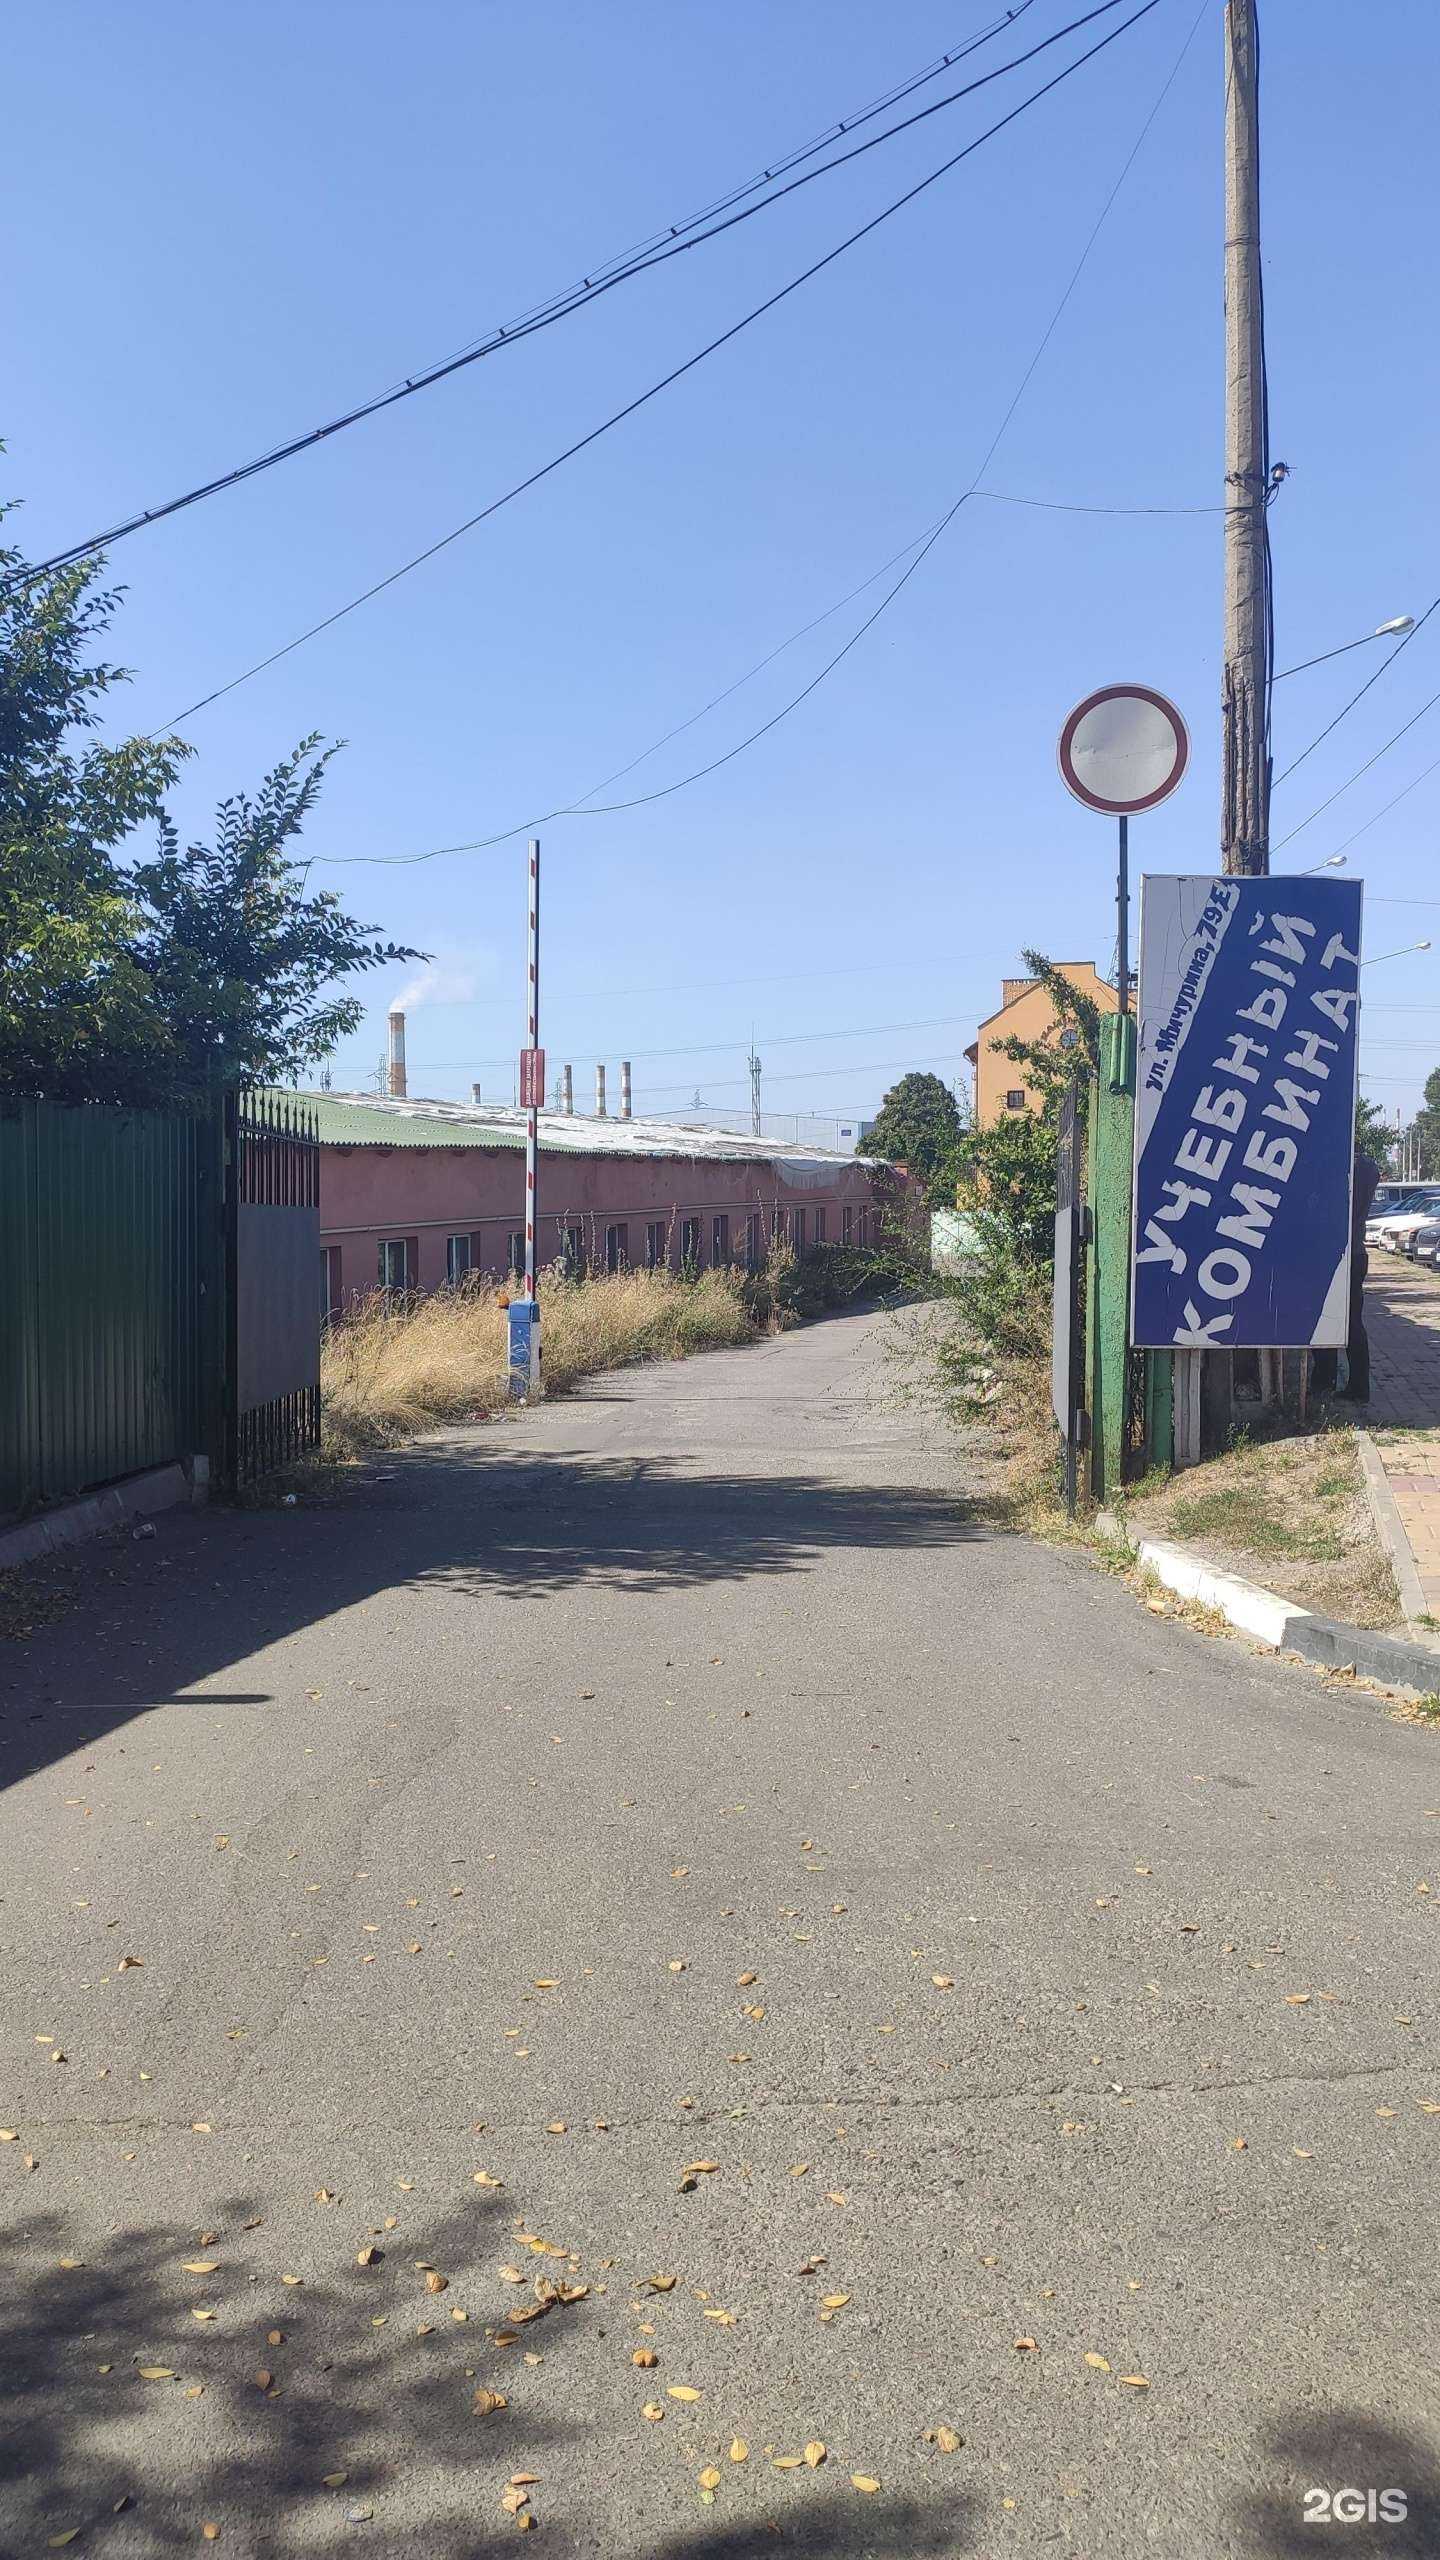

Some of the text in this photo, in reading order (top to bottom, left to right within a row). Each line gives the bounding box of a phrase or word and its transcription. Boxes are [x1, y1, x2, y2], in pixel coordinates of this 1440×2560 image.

[1136, 910, 1317, 1275] УЧЕБНЫЙ
[1146, 1059, 1168, 1091] ул.
[1173, 931, 1359, 1345] КОМБИНАТ
